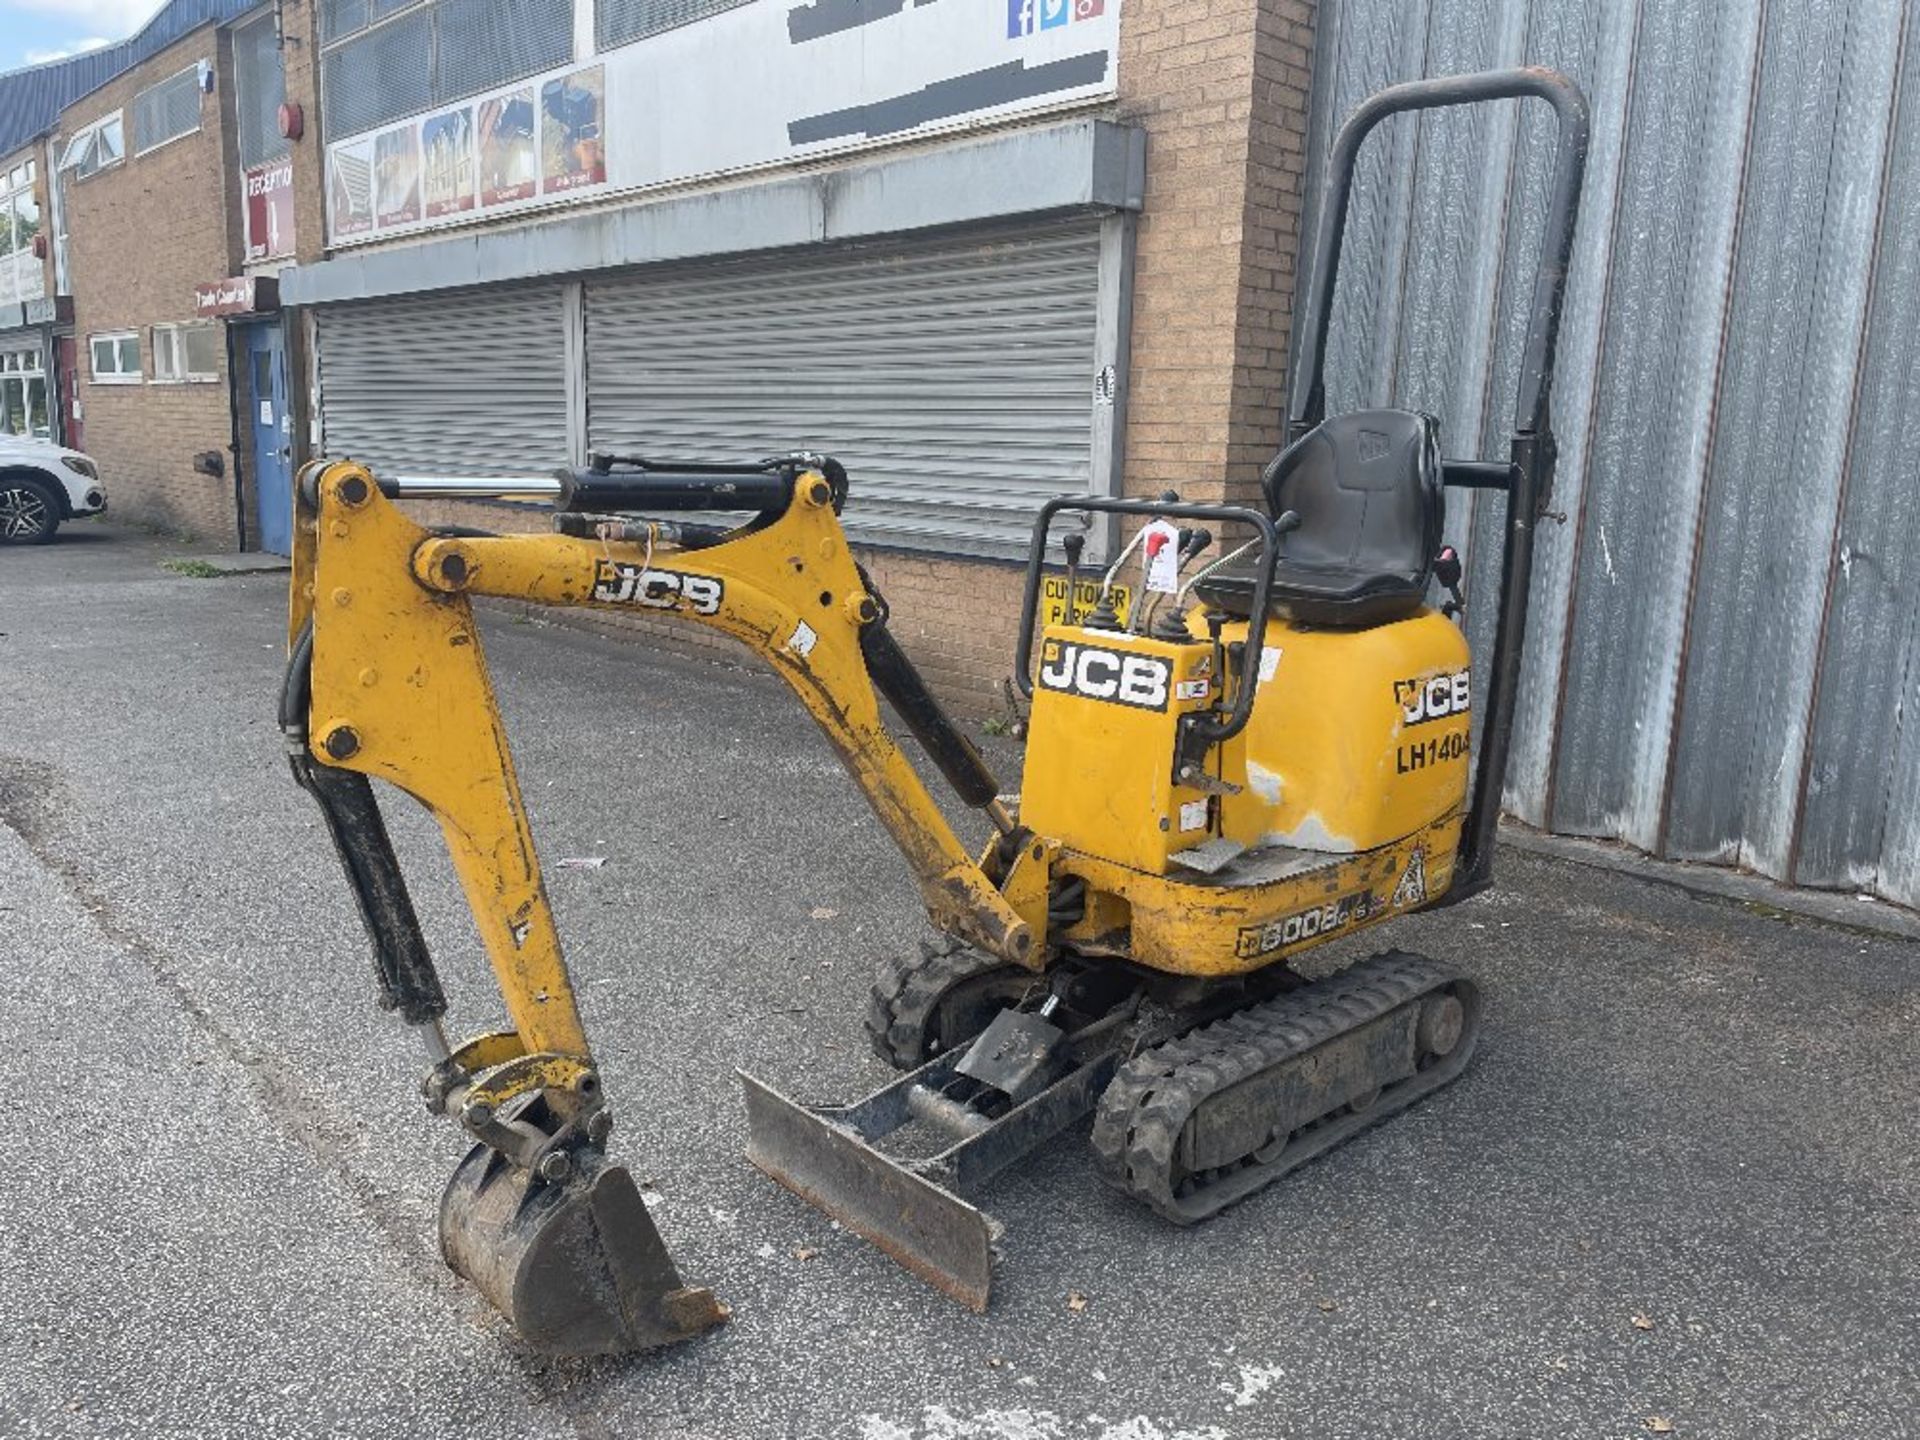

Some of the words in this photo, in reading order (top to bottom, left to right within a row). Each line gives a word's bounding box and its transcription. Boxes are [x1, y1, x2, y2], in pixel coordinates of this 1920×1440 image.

[249, 165, 293, 196] RECEPTIO
[594, 567, 721, 614] JCB
[1045, 580, 1126, 608] CUTOER
[1042, 647, 1168, 706] JCB
[1402, 670, 1470, 722] JCB
